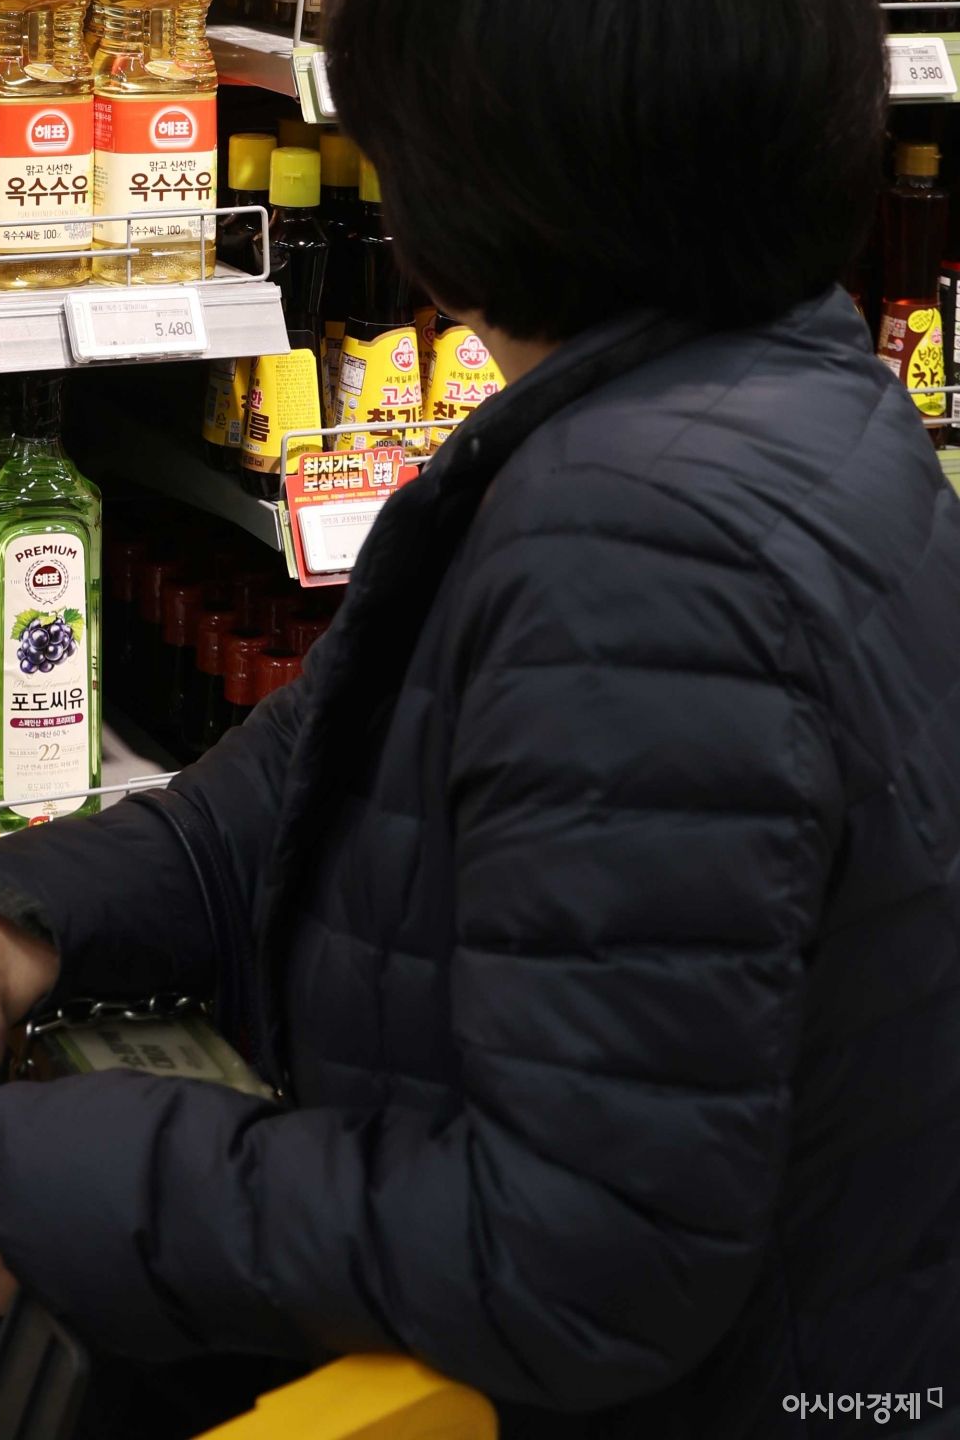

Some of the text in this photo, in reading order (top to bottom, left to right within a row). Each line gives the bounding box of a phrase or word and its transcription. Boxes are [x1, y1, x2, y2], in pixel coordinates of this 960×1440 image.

[909, 67, 943, 80] 8,380
[35, 123, 66, 139] 해표
[158, 120, 189, 136] 해표
[25, 163, 73, 175] 맑고 신선한
[169, 160, 197, 171] 신선한
[5, 175, 89, 207] 옥수수유
[129, 171, 213, 202] 옥수수유
[3, 228, 41, 240] 옥수수씨눈
[154, 321, 193, 337] 5,480
[449, 371, 496, 381] 세계일류상품
[303, 454, 365, 474] 최저가격
[303, 471, 364, 493] 보상적립
[14, 544, 78, 563] PREMIUM
[10, 688, 84, 711] 포도씨유
